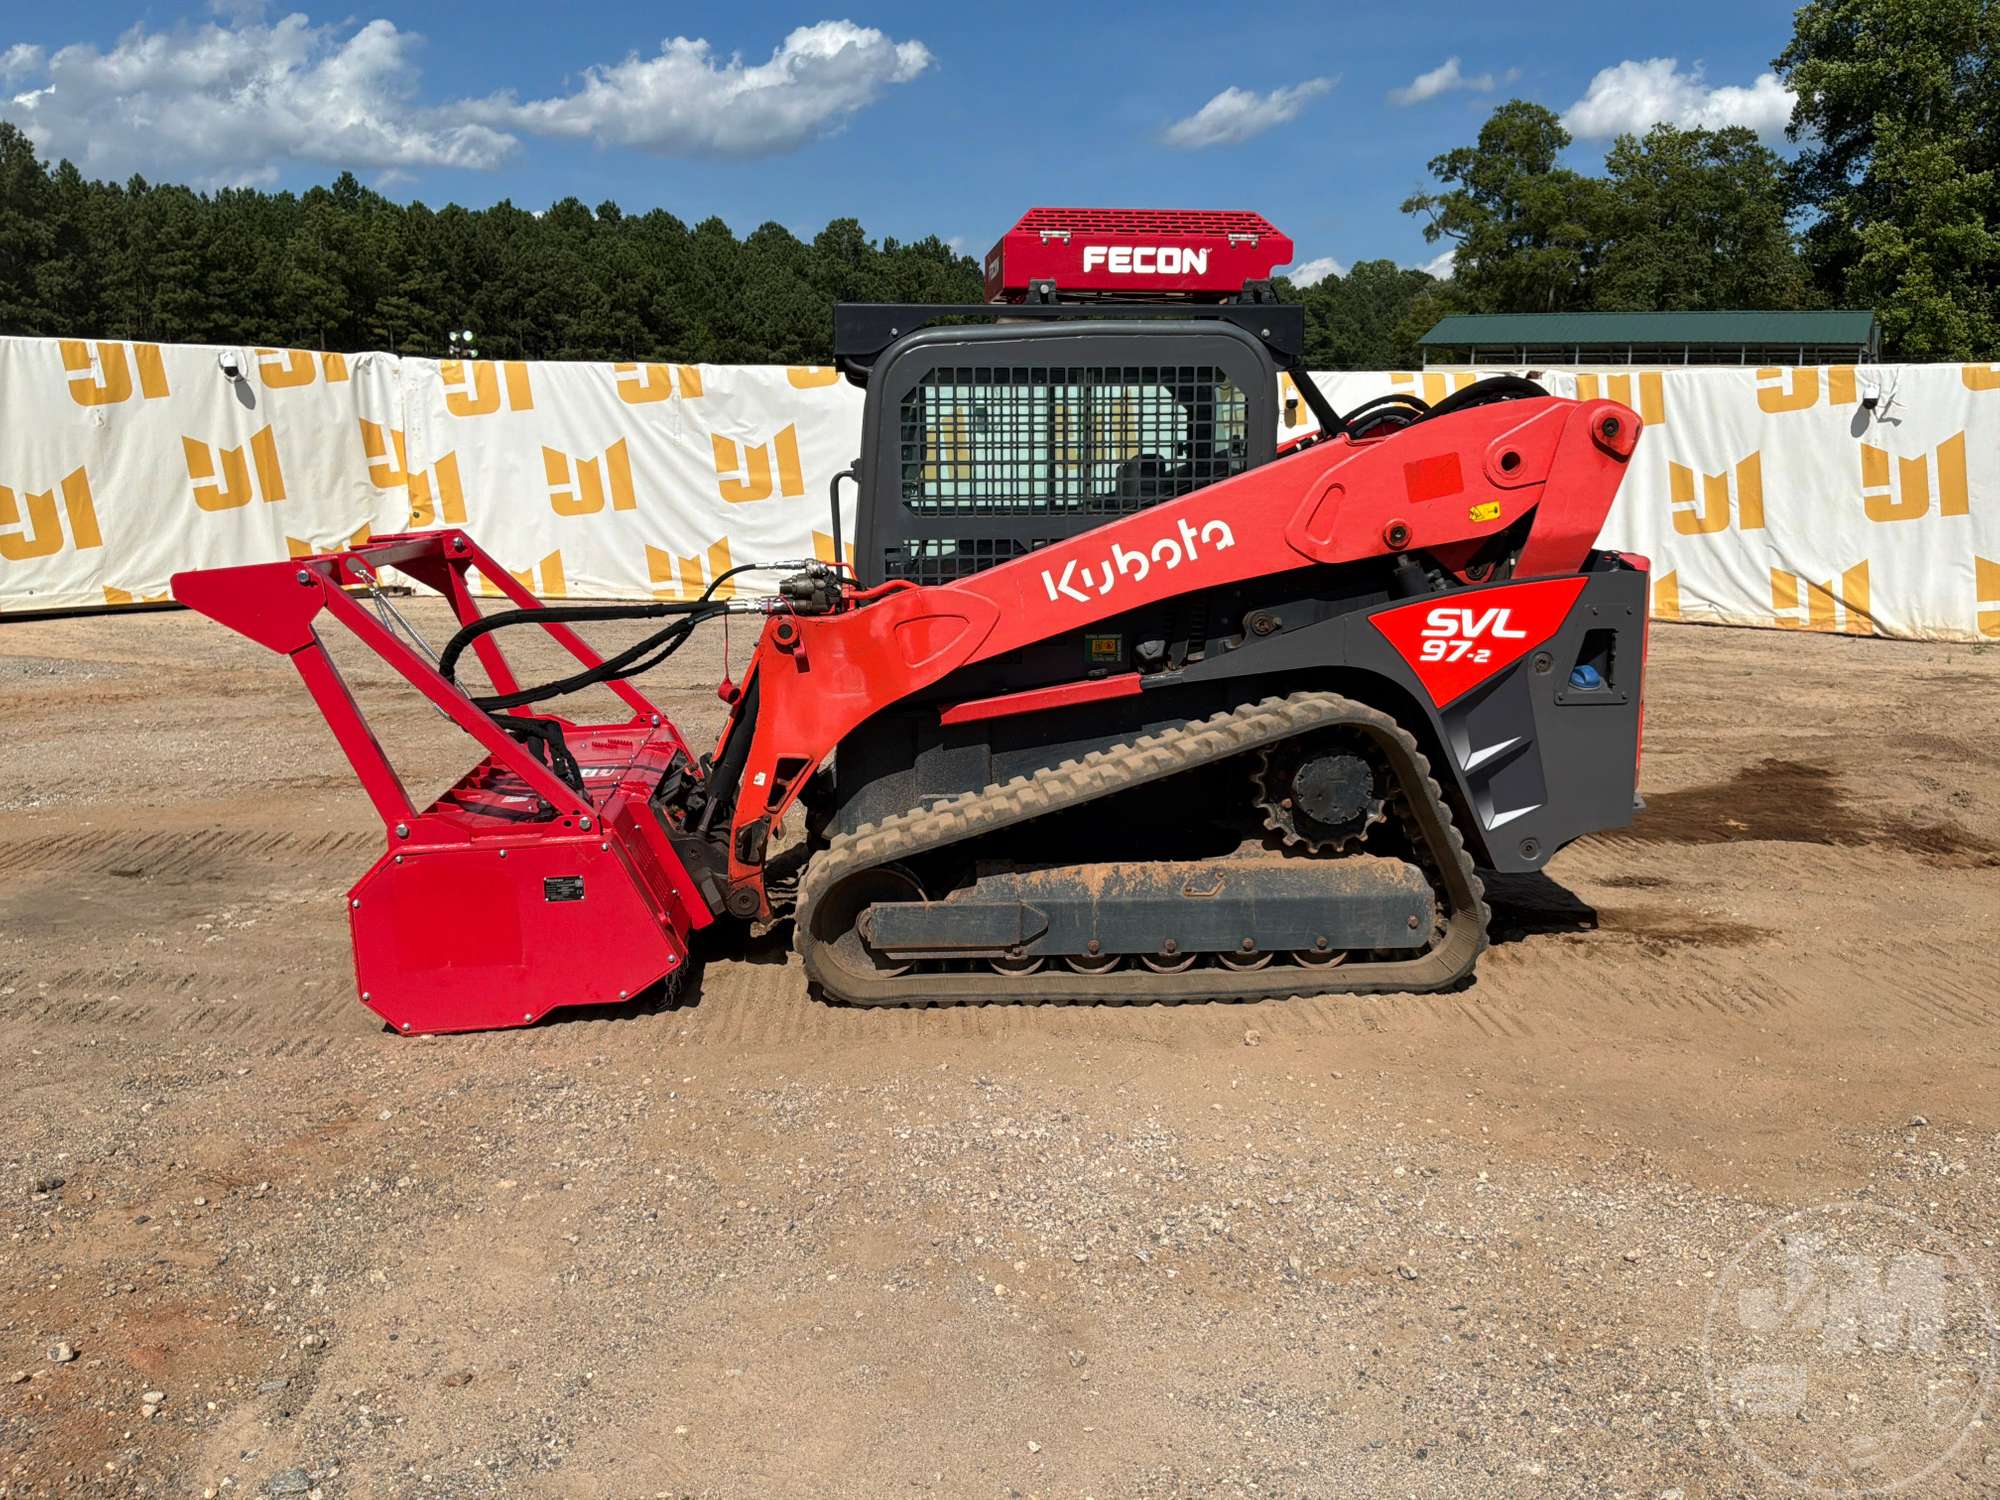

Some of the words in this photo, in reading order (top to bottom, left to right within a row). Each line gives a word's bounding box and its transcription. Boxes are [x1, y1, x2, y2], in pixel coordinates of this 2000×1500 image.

[1083, 246, 1208, 275] FECON
[1041, 518, 1235, 603] Kubota
[1421, 607, 1526, 638] SVL
[1420, 639, 1491, 663] 97-2
